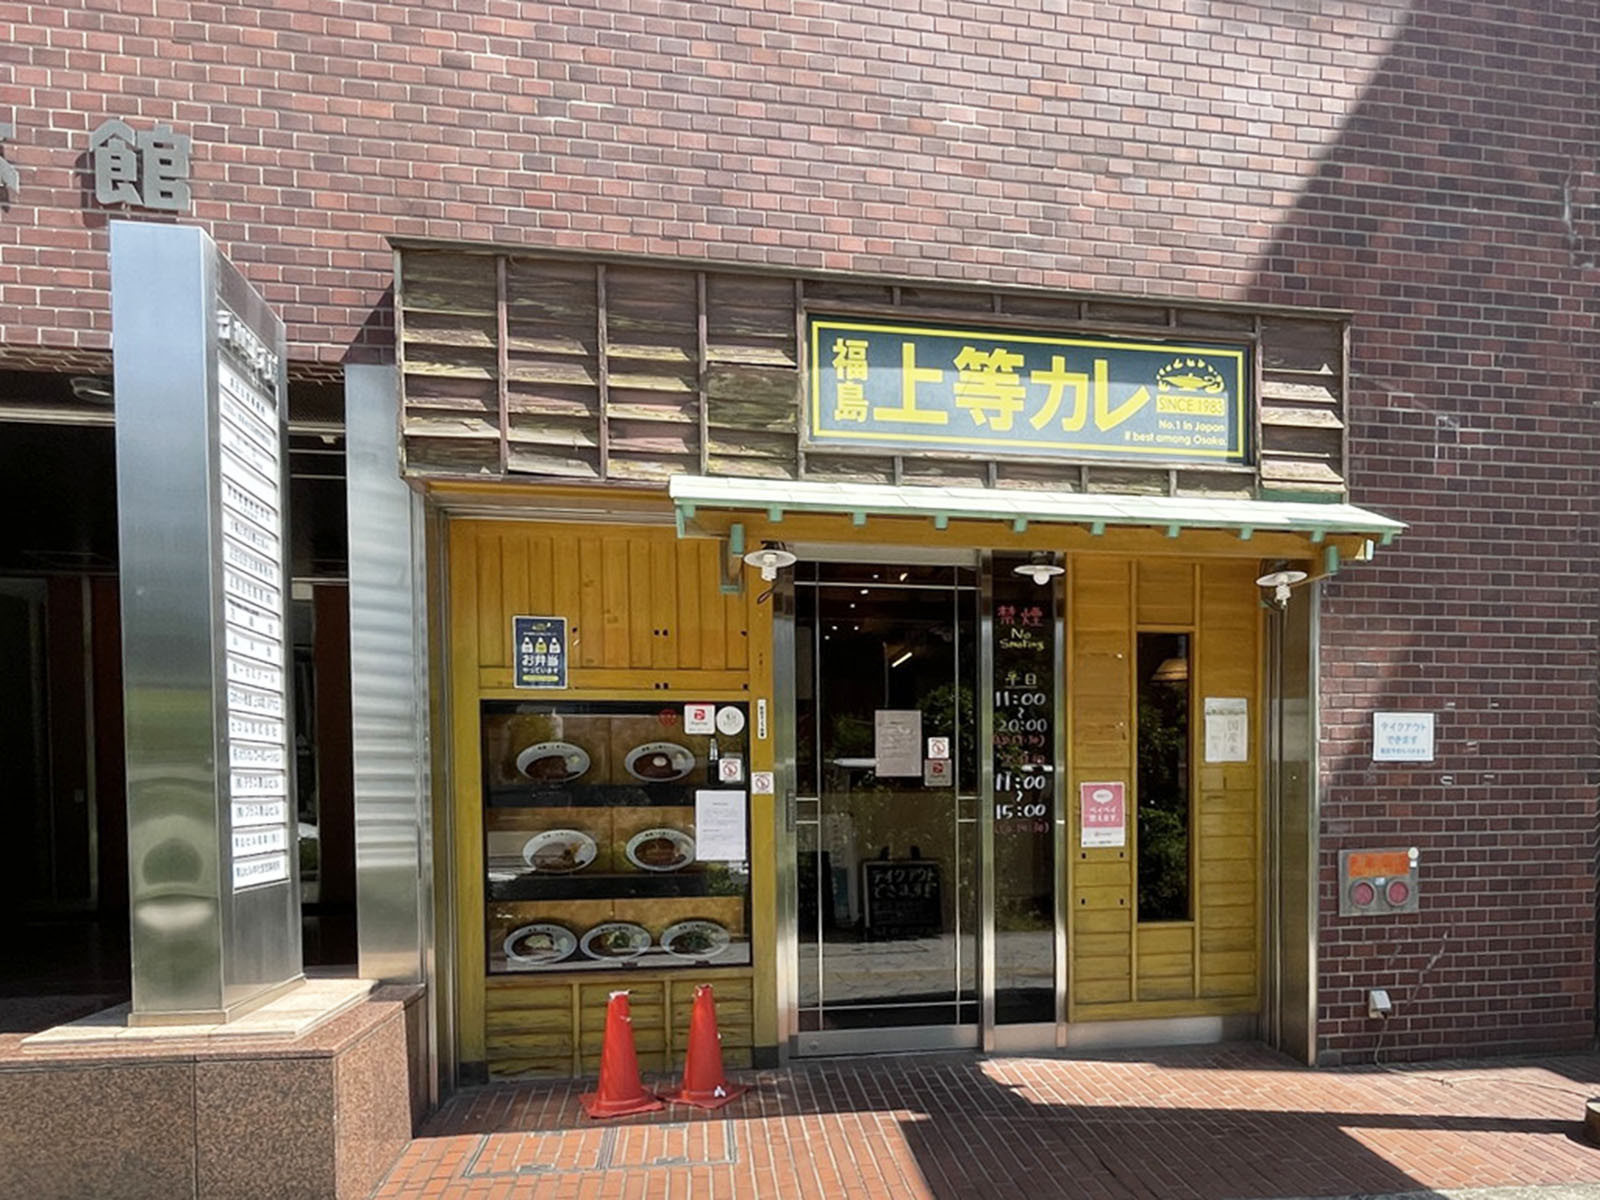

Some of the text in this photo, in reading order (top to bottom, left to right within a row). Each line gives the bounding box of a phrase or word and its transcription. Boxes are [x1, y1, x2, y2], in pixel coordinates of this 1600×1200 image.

[832, 338, 868, 422] 福島
[873, 342, 1150, 432] 上等カレ
[1158, 396, 1224, 414] SINCE 1983
[1158, 420, 1180, 430] No.1
[1194, 421, 1225, 433] Japan
[1132, 431, 1154, 442] best
[998, 605, 1044, 626] 禁煙
[1011, 627, 1032, 639] No
[1000, 638, 1045, 652] Smoking
[521, 654, 559, 667] お弁当
[1005, 670, 1037, 686] 平日
[995, 691, 1046, 707] 11:00
[999, 718, 1047, 732] 20:00
[1380, 721, 1426, 732] テイクアウト
[1387, 735, 1418, 745] できます
[995, 773, 1046, 791] 11:00
[996, 804, 1047, 819] 15:00
